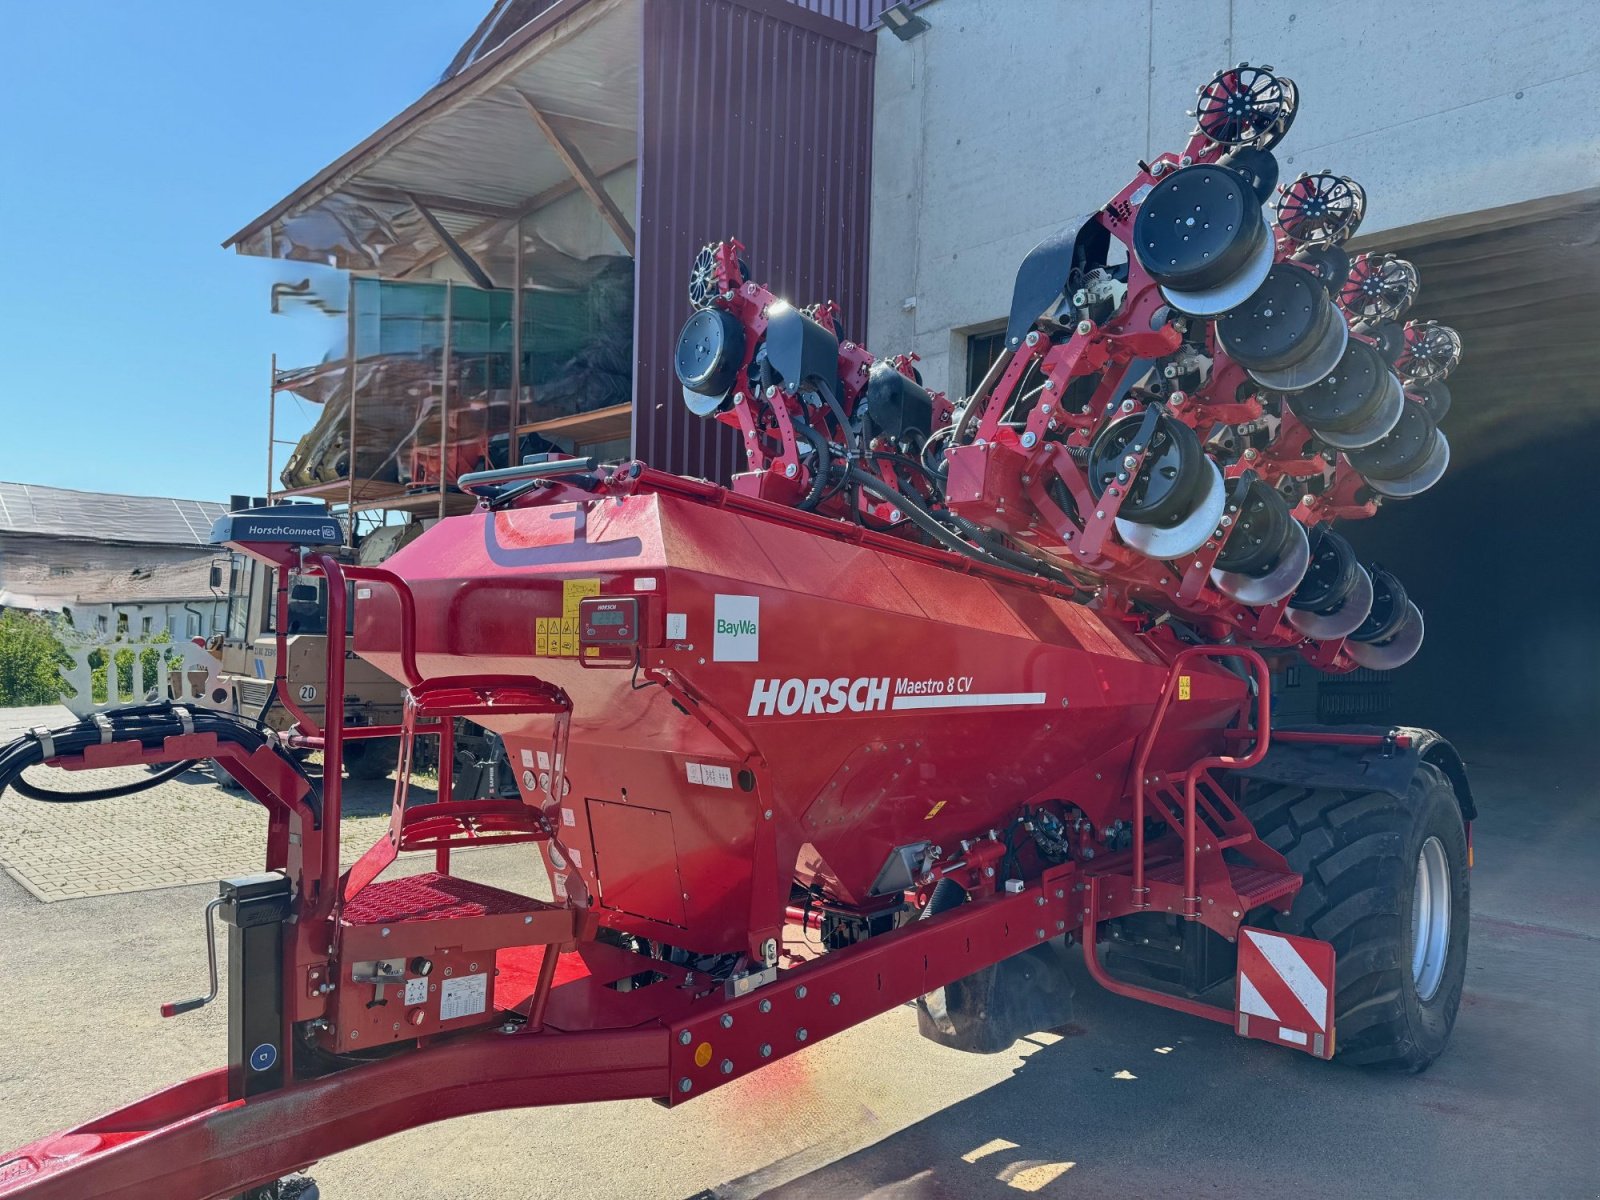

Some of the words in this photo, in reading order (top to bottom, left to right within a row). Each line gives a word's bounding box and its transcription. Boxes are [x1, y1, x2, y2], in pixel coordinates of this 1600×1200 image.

[248, 525, 321, 536] HorschConnect
[717, 619, 757, 637] BayWa
[301, 686, 314, 699] 20
[895, 678, 944, 695] Maestro
[946, 677, 954, 693] 8
[957, 676, 974, 693] CV
[747, 677, 891, 717] HORSCH
